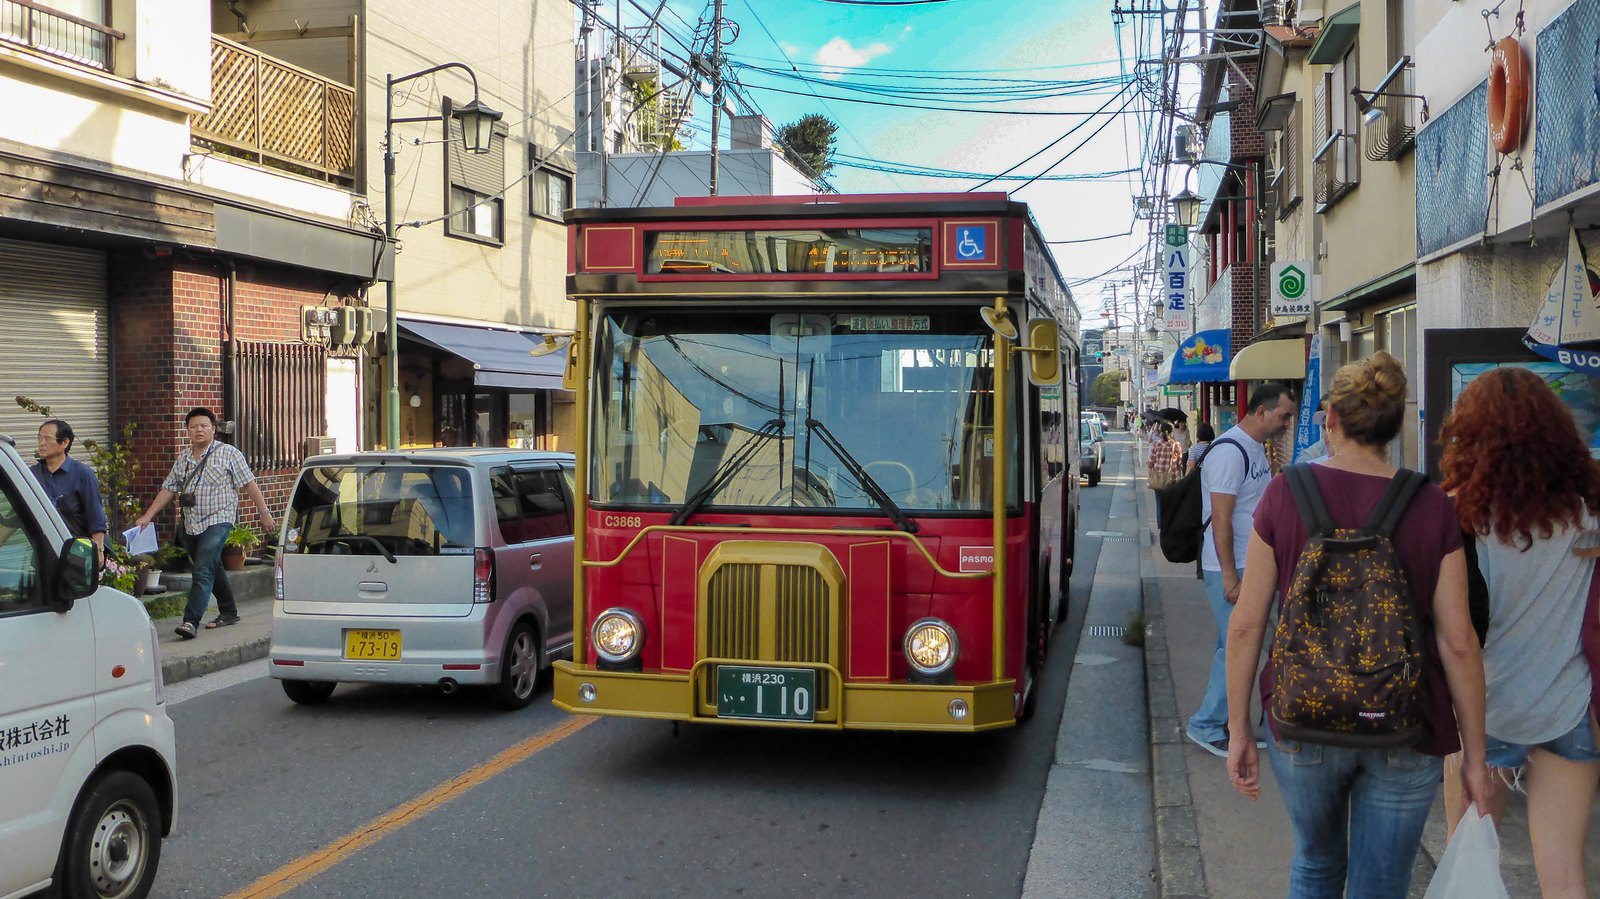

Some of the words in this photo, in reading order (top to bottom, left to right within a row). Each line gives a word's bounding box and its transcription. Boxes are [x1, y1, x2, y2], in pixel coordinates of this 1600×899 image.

[1168, 250, 1186, 311] 八百定
[605, 515, 641, 528] C3868
[962, 555, 993, 563] PASMO
[359, 641, 399, 657] 73-19
